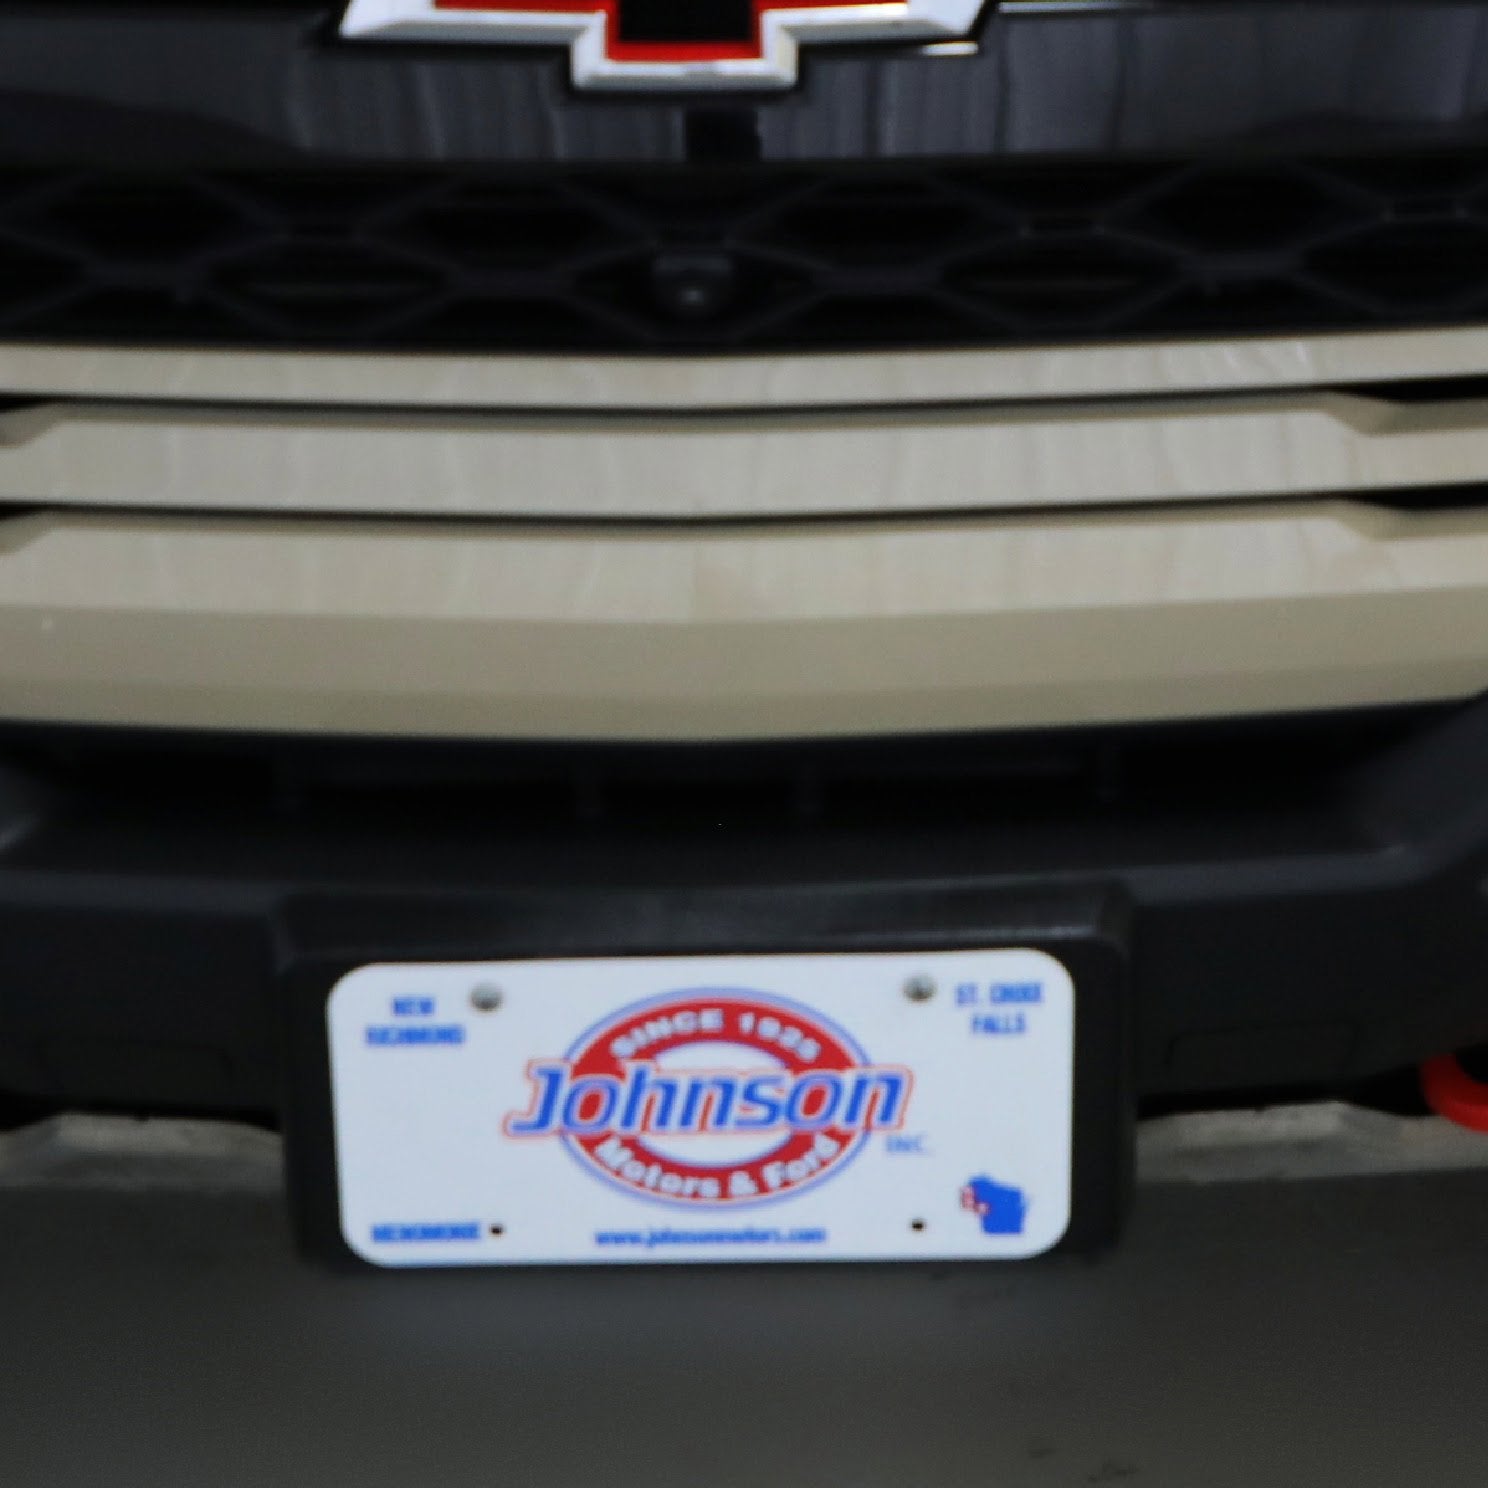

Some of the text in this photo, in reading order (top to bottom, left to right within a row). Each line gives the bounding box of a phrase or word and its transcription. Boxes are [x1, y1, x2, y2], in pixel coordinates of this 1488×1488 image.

[610, 1008, 724, 1060] SINCE
[506, 1063, 908, 1134] Johnson
[593, 1131, 841, 1199] Motors & Ford
